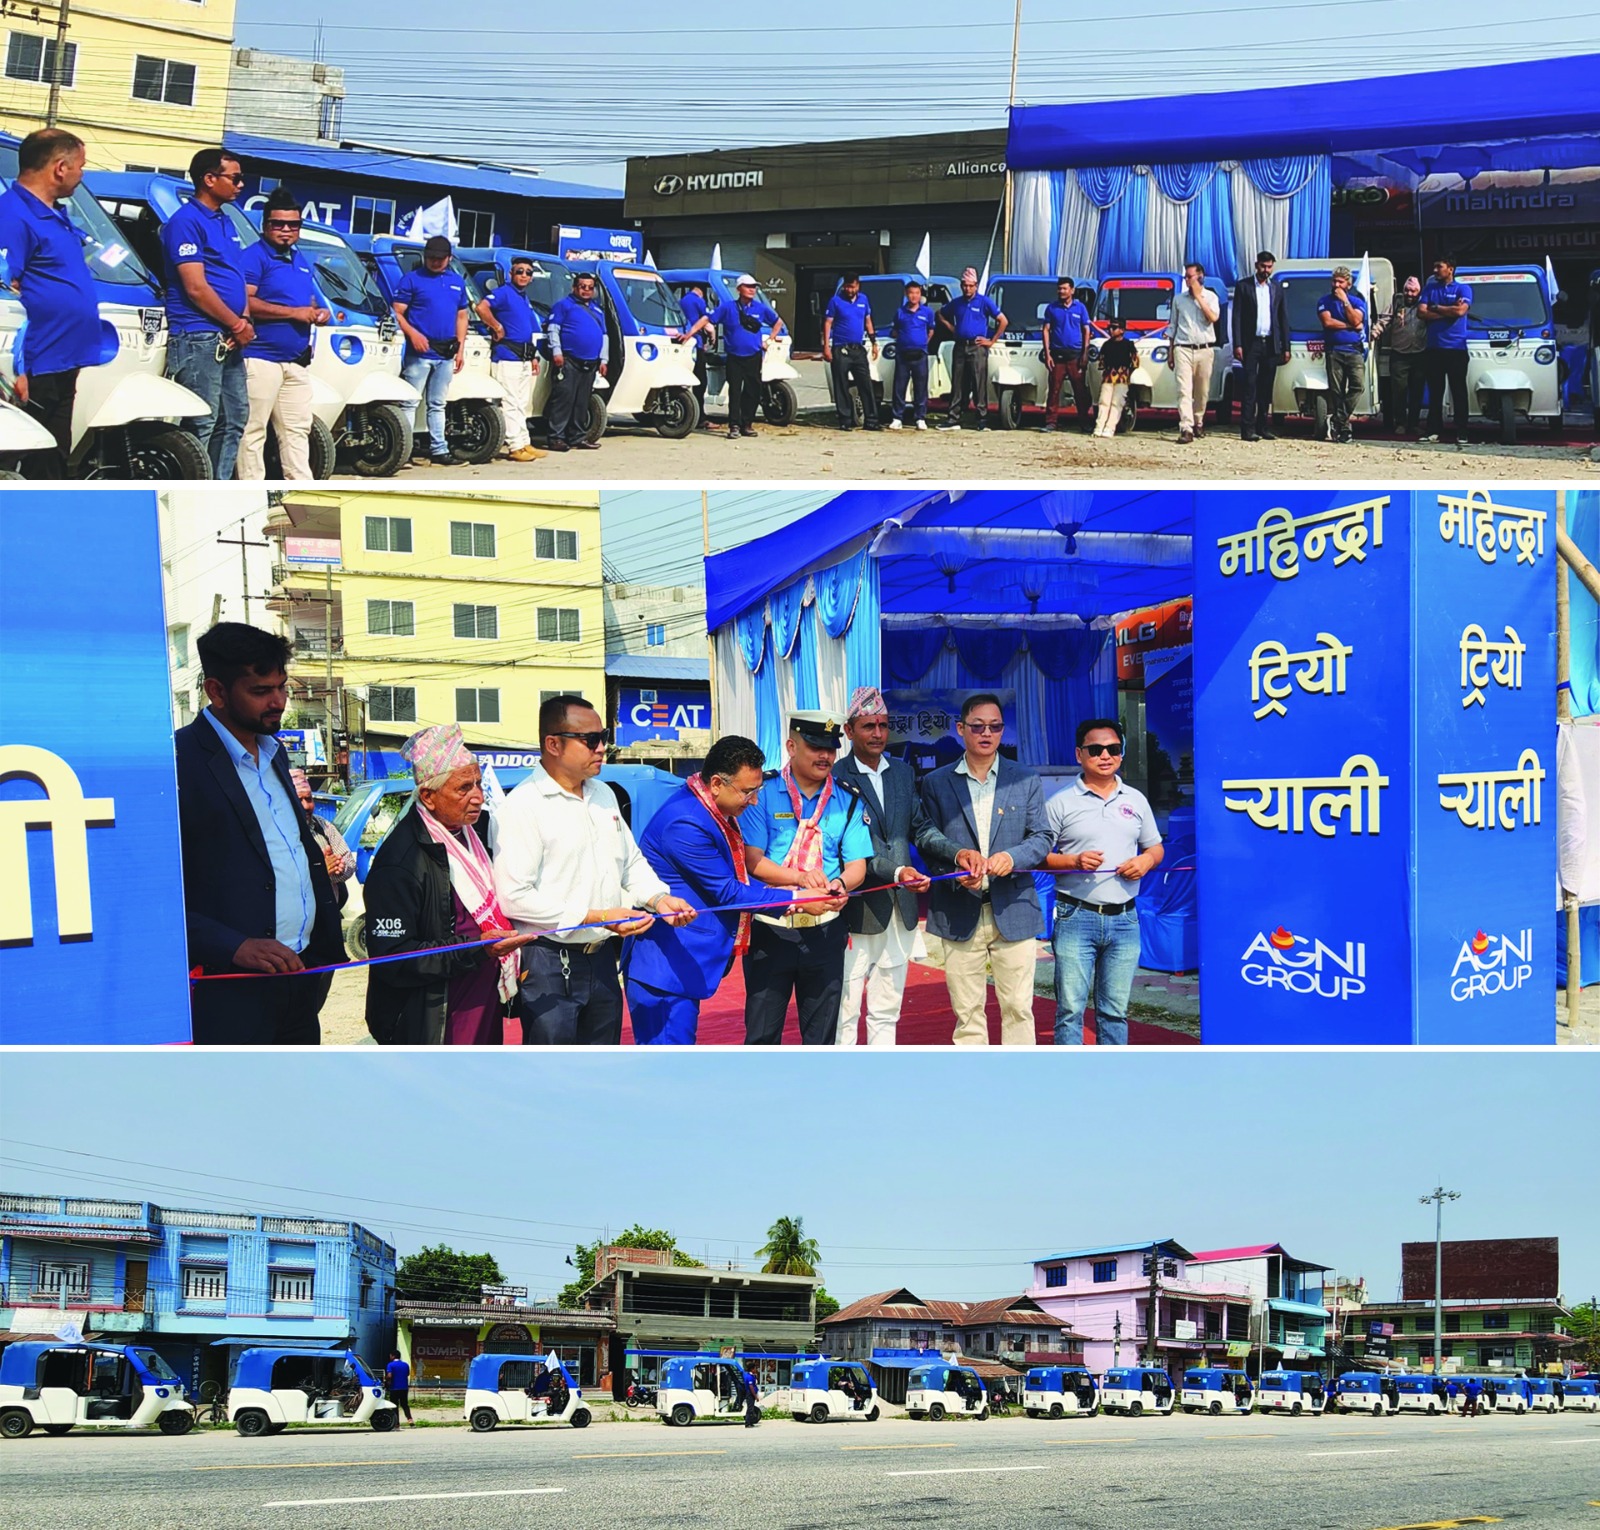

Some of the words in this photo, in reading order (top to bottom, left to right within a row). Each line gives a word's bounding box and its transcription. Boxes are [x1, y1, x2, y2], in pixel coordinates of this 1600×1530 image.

[687, 170, 763, 190] HYUNDAI
[947, 161, 1006, 175] Alliance
[243, 195, 341, 226] CAT
[1217, 495, 1391, 579] महिन्द्रा
[1248, 632, 1353, 719] ट्रियो
[1459, 623, 1526, 708] ट्रियो
[631, 703, 705, 727] CEAT
[376, 918, 402, 930] X06
[1241, 929, 1366, 978] AGNI
[1451, 928, 1533, 977] AGNI
[1241, 963, 1366, 1000] GROUP
[1451, 964, 1533, 1002] GROUP
[416, 1346, 470, 1356] OLYMPIC
